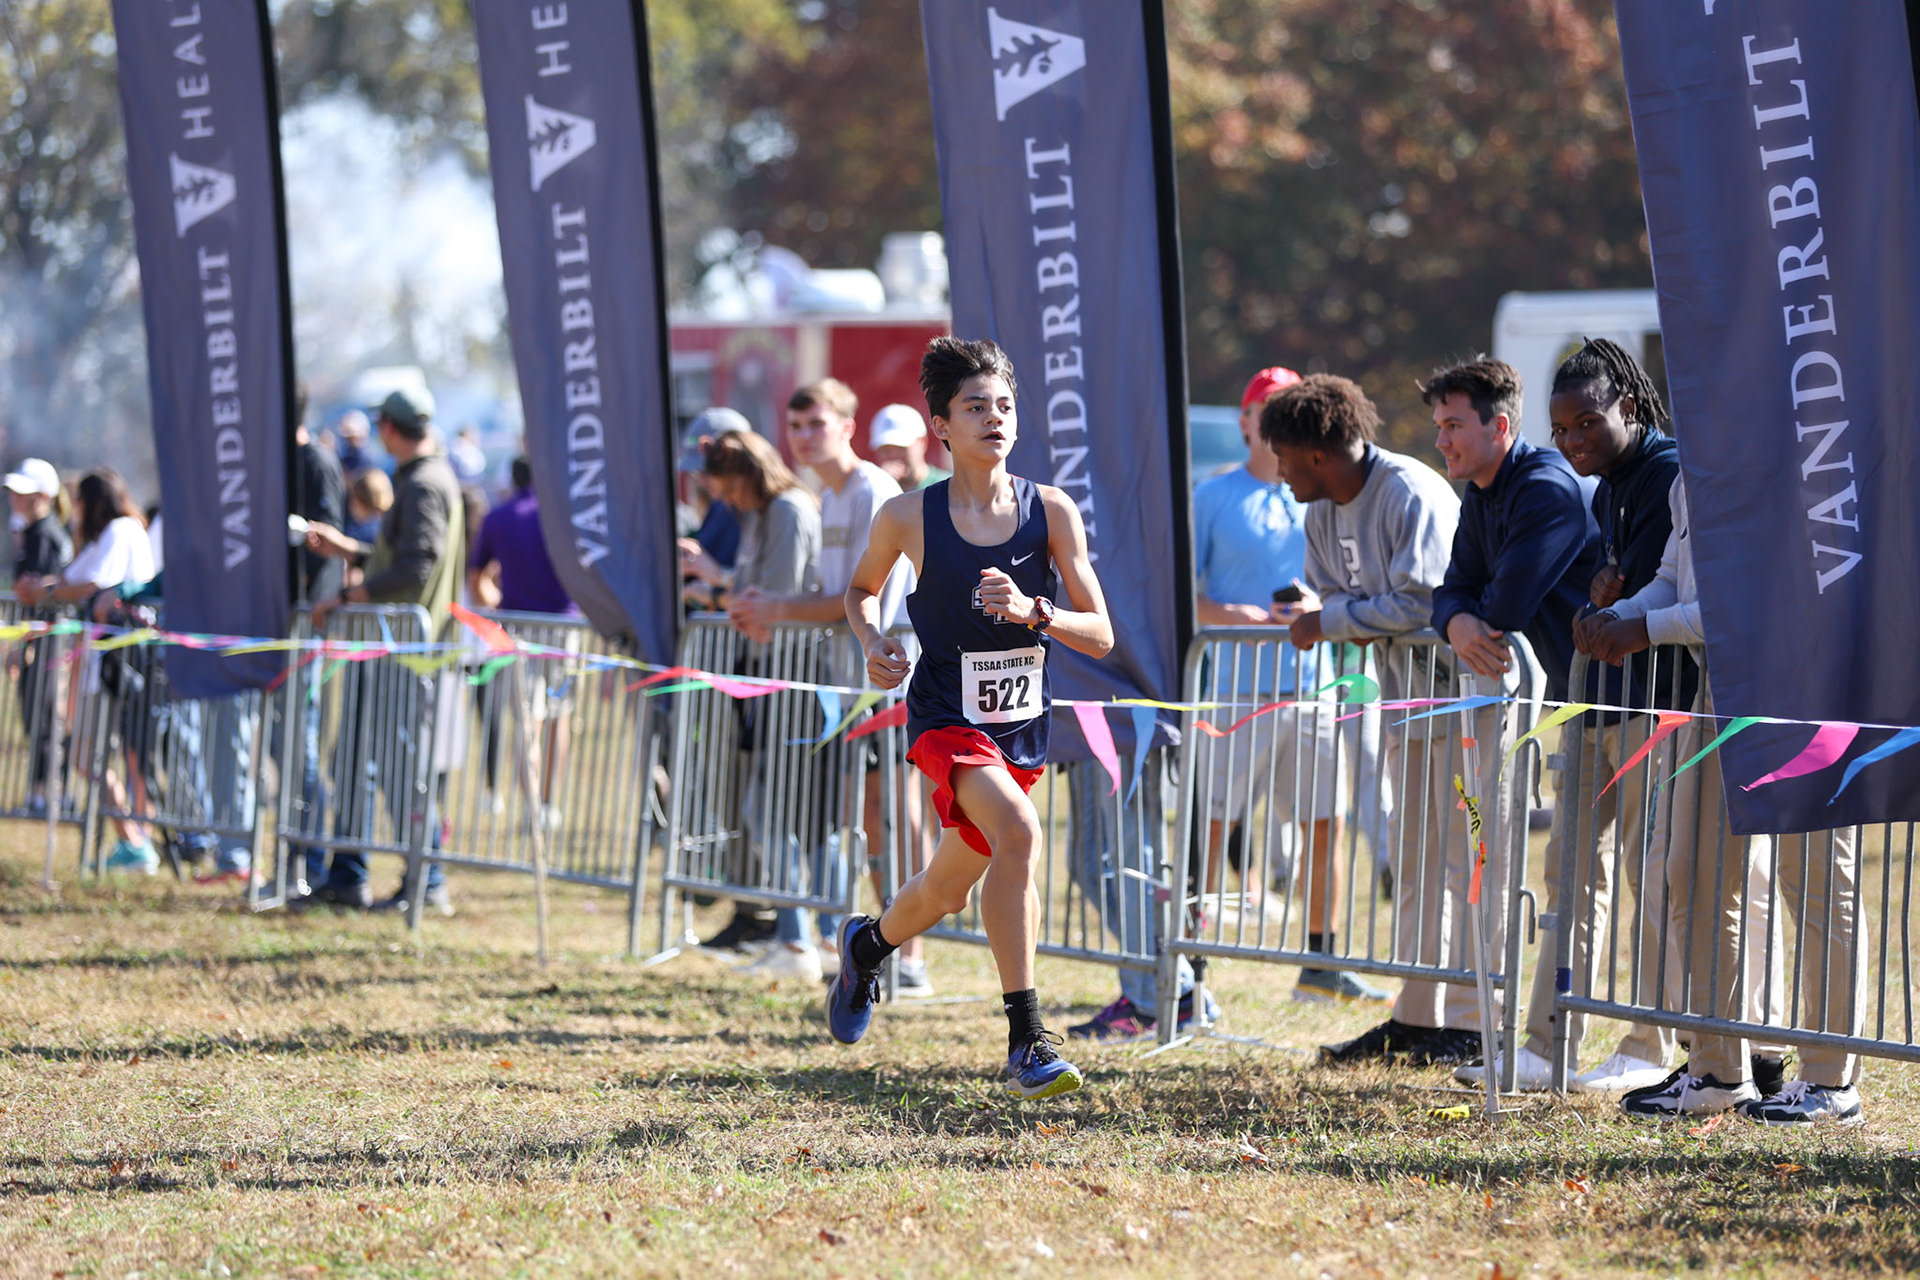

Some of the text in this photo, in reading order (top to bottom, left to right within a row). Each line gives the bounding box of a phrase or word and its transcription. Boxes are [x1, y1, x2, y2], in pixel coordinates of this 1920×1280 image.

[169, 0, 215, 139] HEAL
[197, 247, 251, 568] VANDERBILT
[551, 202, 609, 568] VANDERBILT
[1024, 137, 1099, 563] NDERBILT
[1741, 34, 1863, 595] VANDERBILT
[972, 655, 1034, 672] TSSAA STATE XC
[978, 675, 1030, 713] 522
